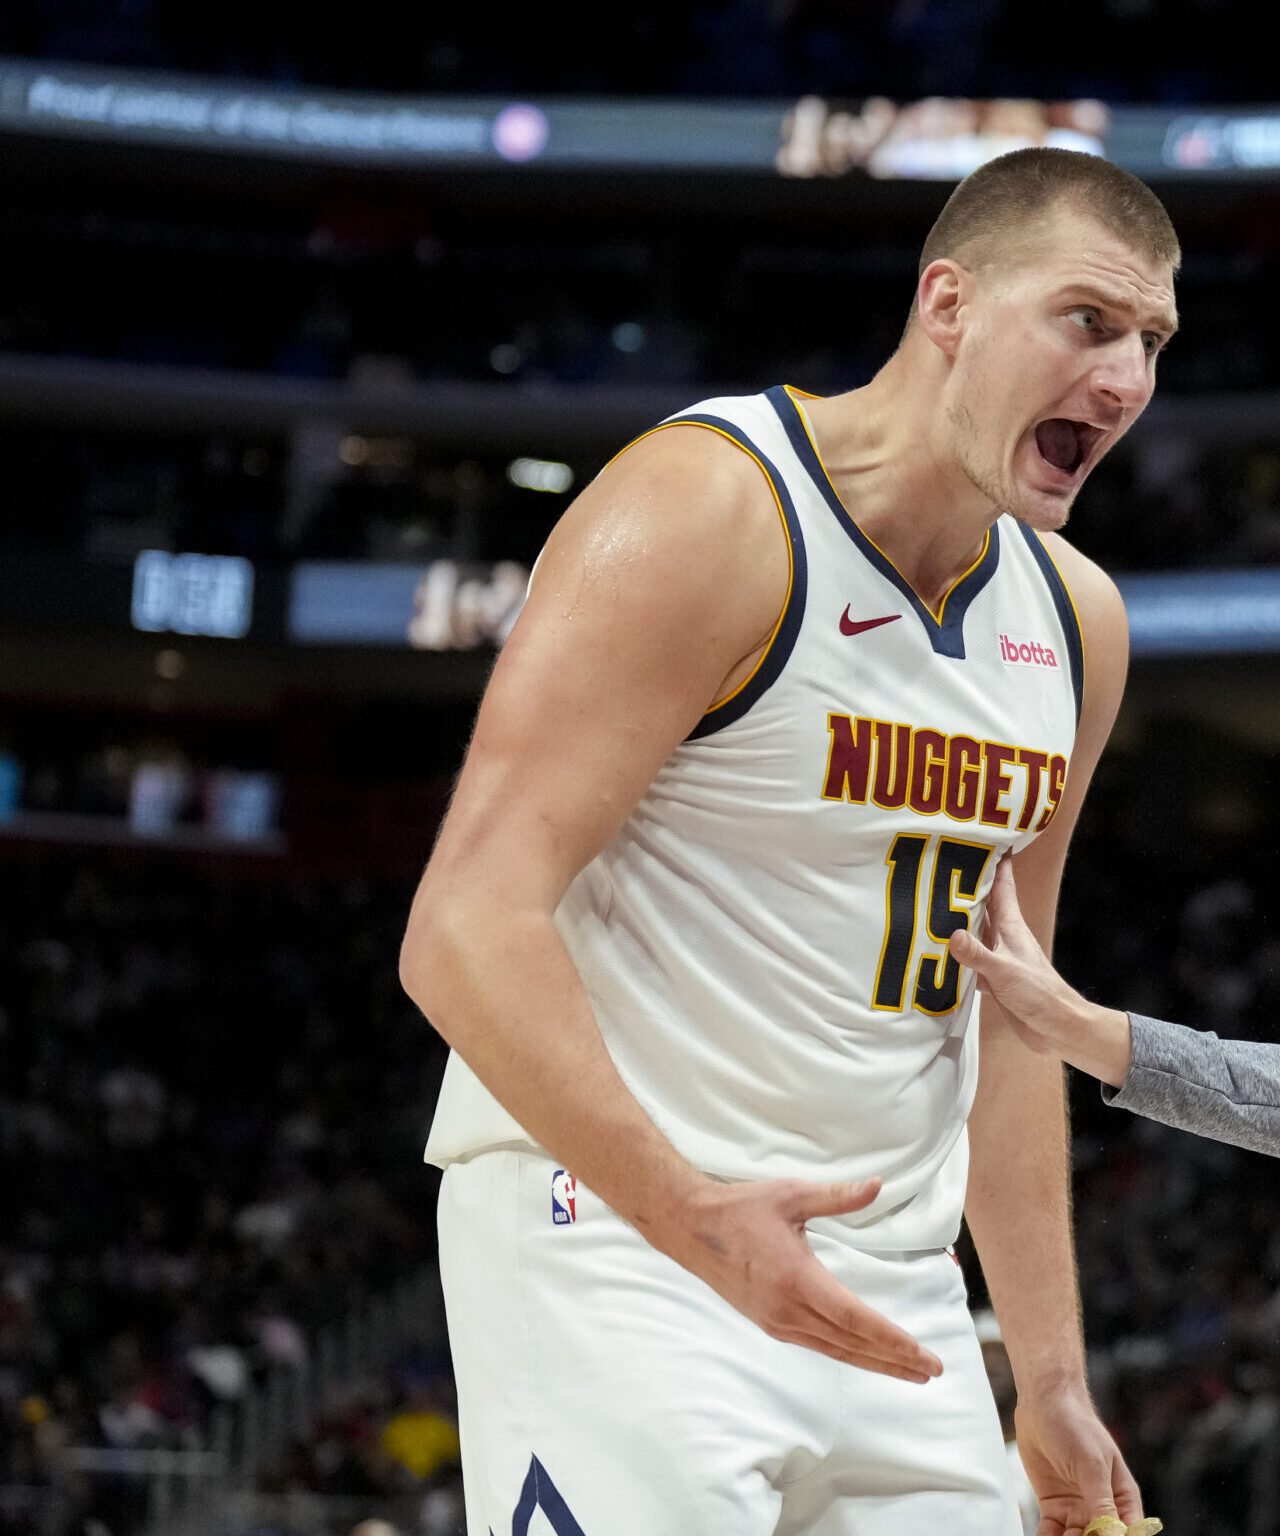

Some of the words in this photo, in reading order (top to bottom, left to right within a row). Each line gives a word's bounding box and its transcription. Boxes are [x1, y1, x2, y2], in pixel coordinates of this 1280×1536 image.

[1000, 634, 1057, 667] ibotta
[822, 712, 1067, 833] NUGGETS
[871, 832, 994, 1017] 15
